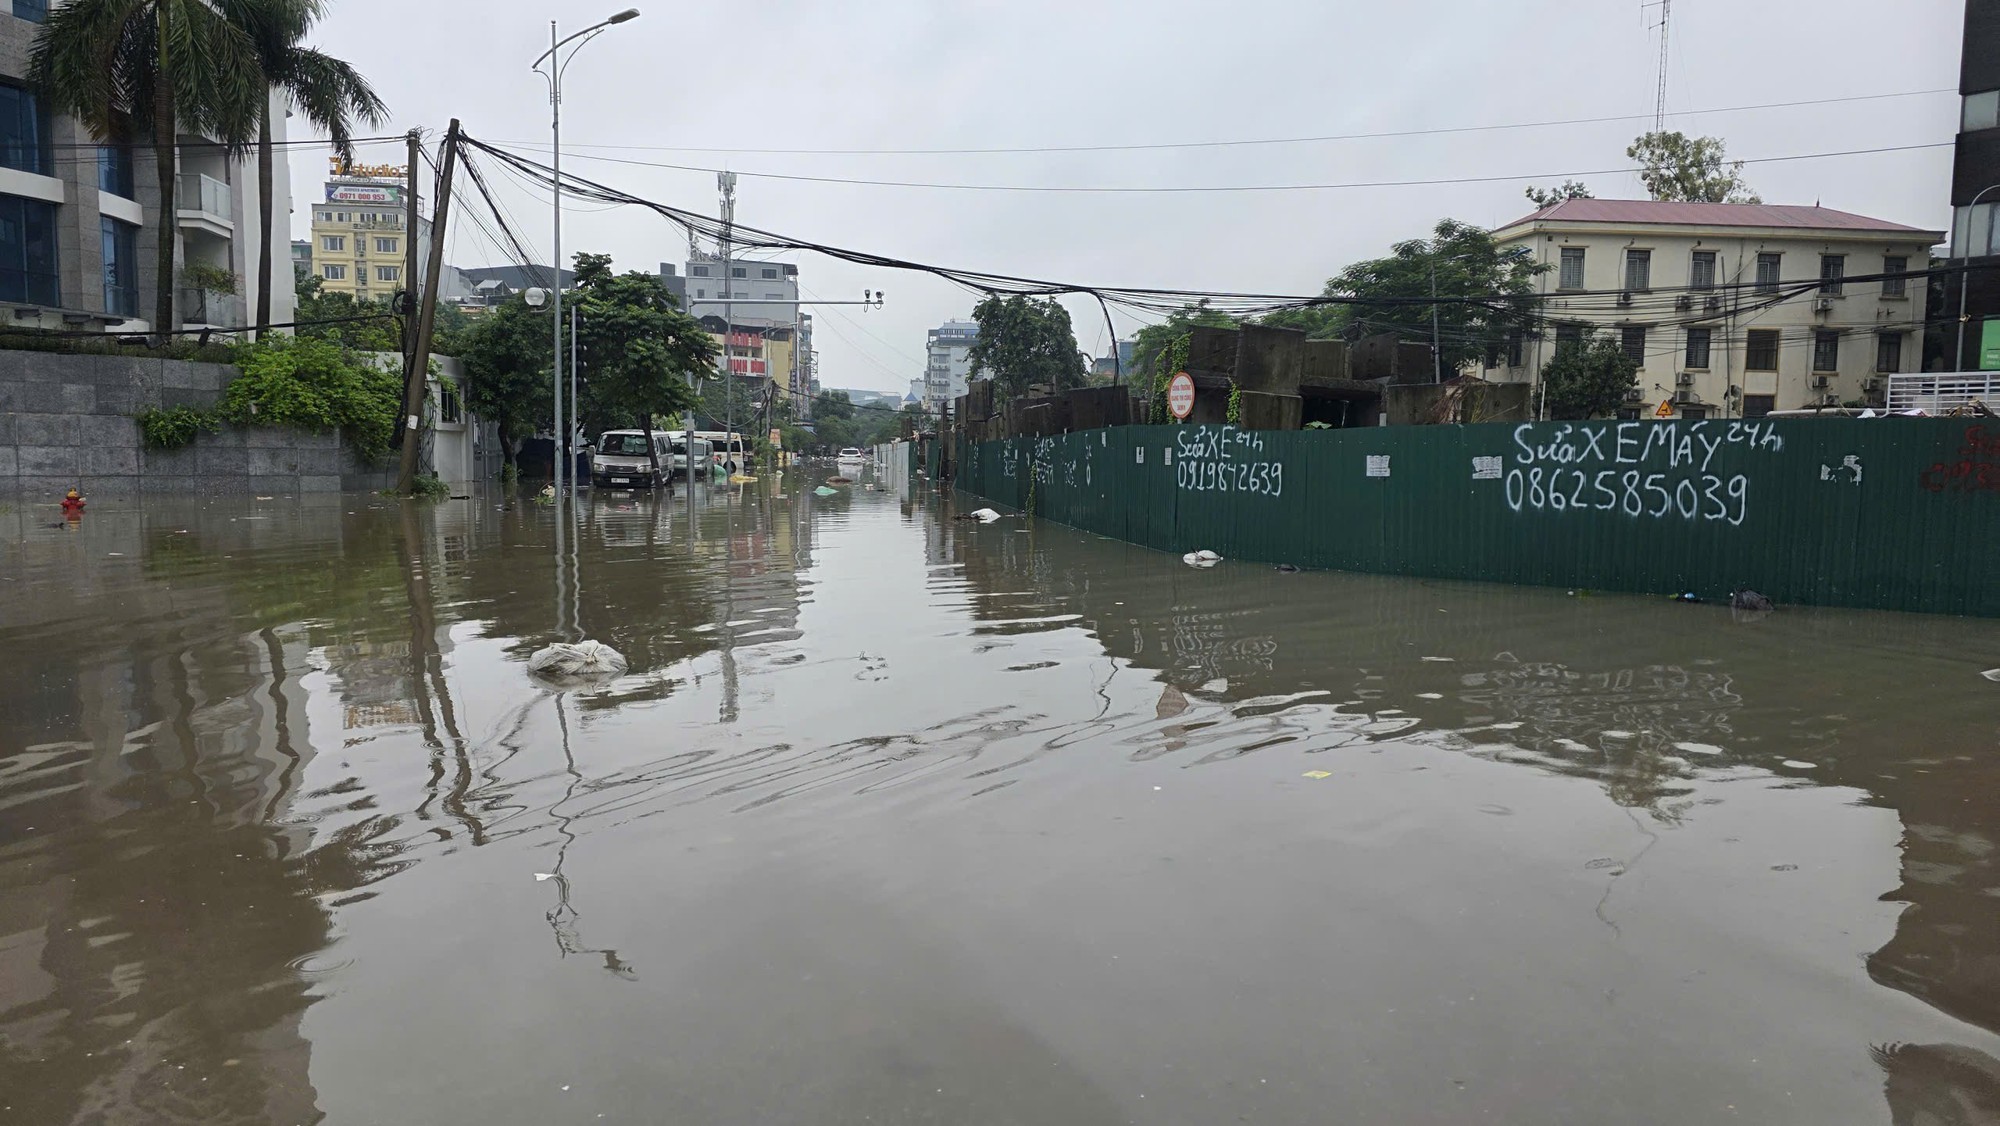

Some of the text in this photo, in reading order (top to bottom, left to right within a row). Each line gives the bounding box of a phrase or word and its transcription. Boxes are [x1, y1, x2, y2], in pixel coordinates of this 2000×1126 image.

[351, 163, 400, 177] studio
[1178, 460, 1283, 497] 0919842639
[1506, 467, 1748, 526] 0862585039
